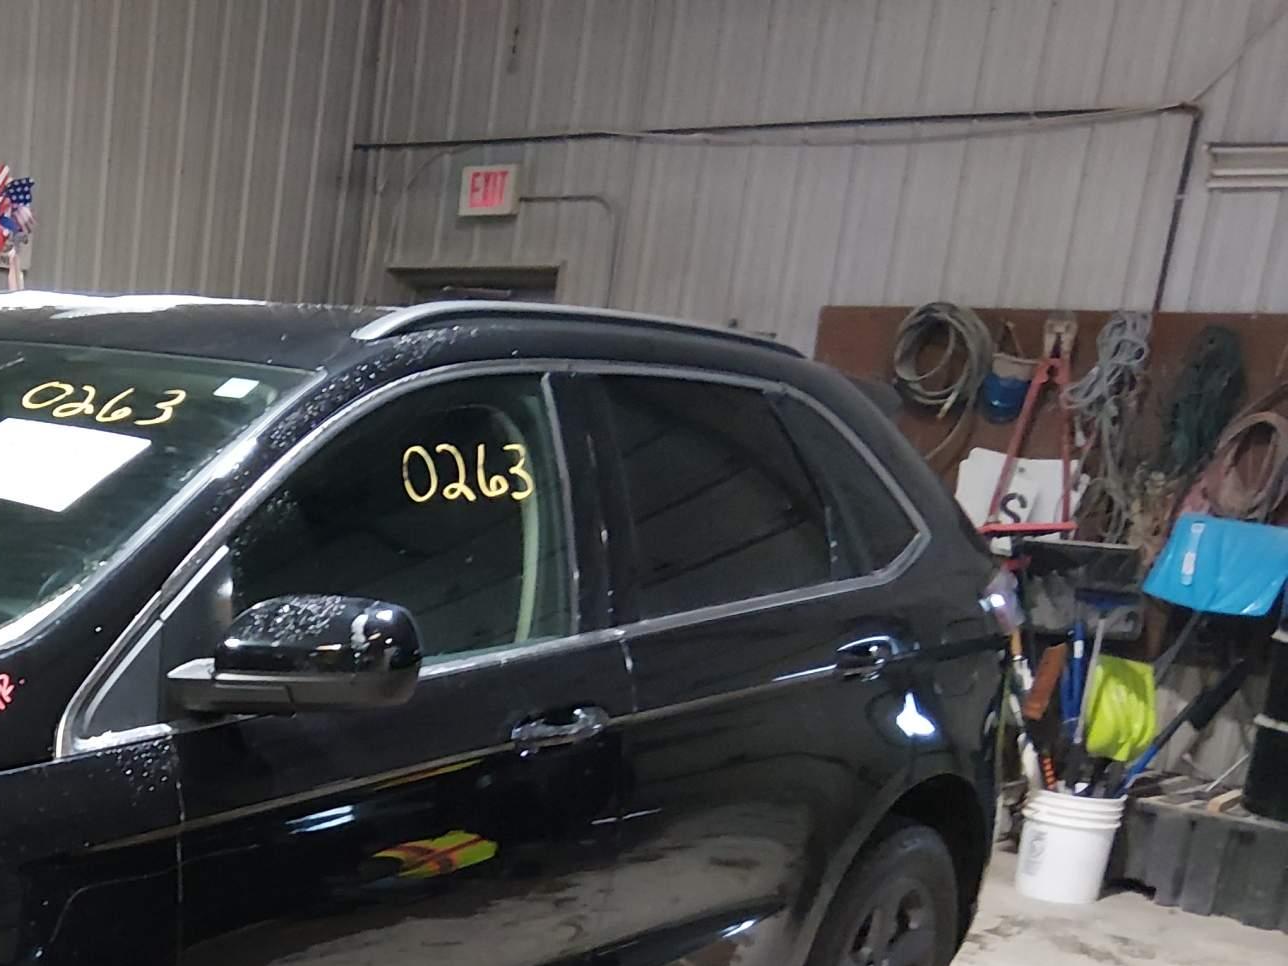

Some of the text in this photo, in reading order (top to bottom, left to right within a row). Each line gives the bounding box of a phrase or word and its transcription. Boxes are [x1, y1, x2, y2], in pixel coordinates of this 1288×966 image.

[470, 171, 508, 207] EXIT
[22, 381, 186, 426] 0263
[402, 443, 535, 503] 0263
